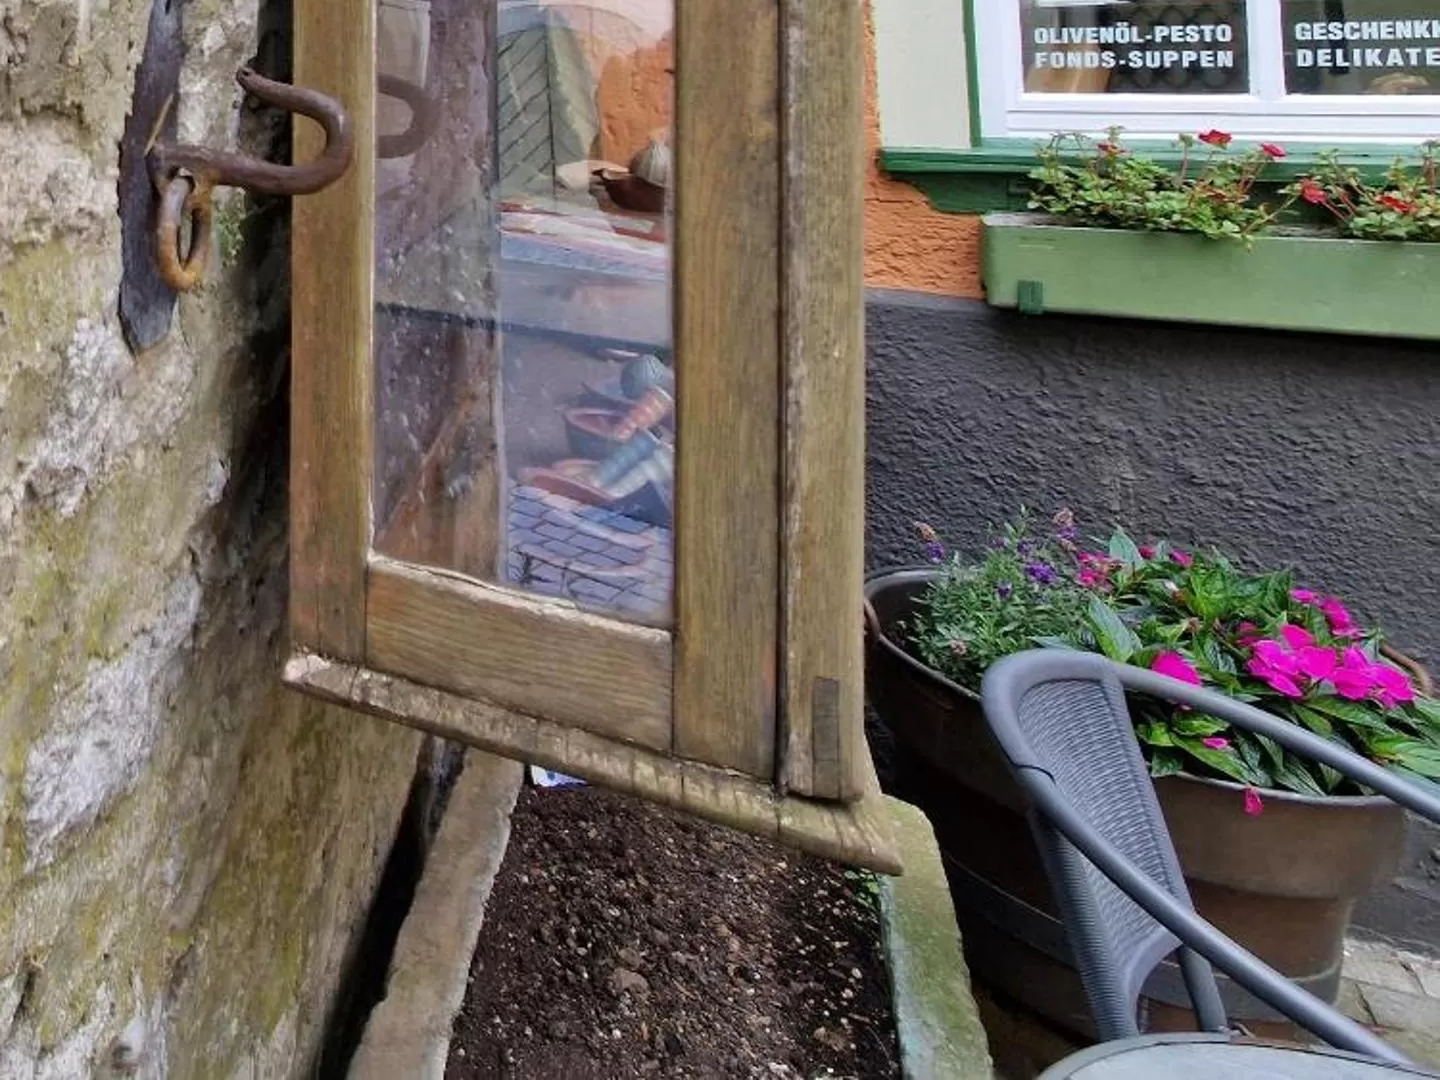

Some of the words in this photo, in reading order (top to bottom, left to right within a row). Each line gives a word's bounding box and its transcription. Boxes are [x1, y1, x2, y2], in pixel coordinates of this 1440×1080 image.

[1034, 22, 1232, 45] OLIVENÖL-PESTO
[1035, 50, 1234, 69] FONDS-SUPPEN
[1297, 48, 1440, 68] DELIKATE
